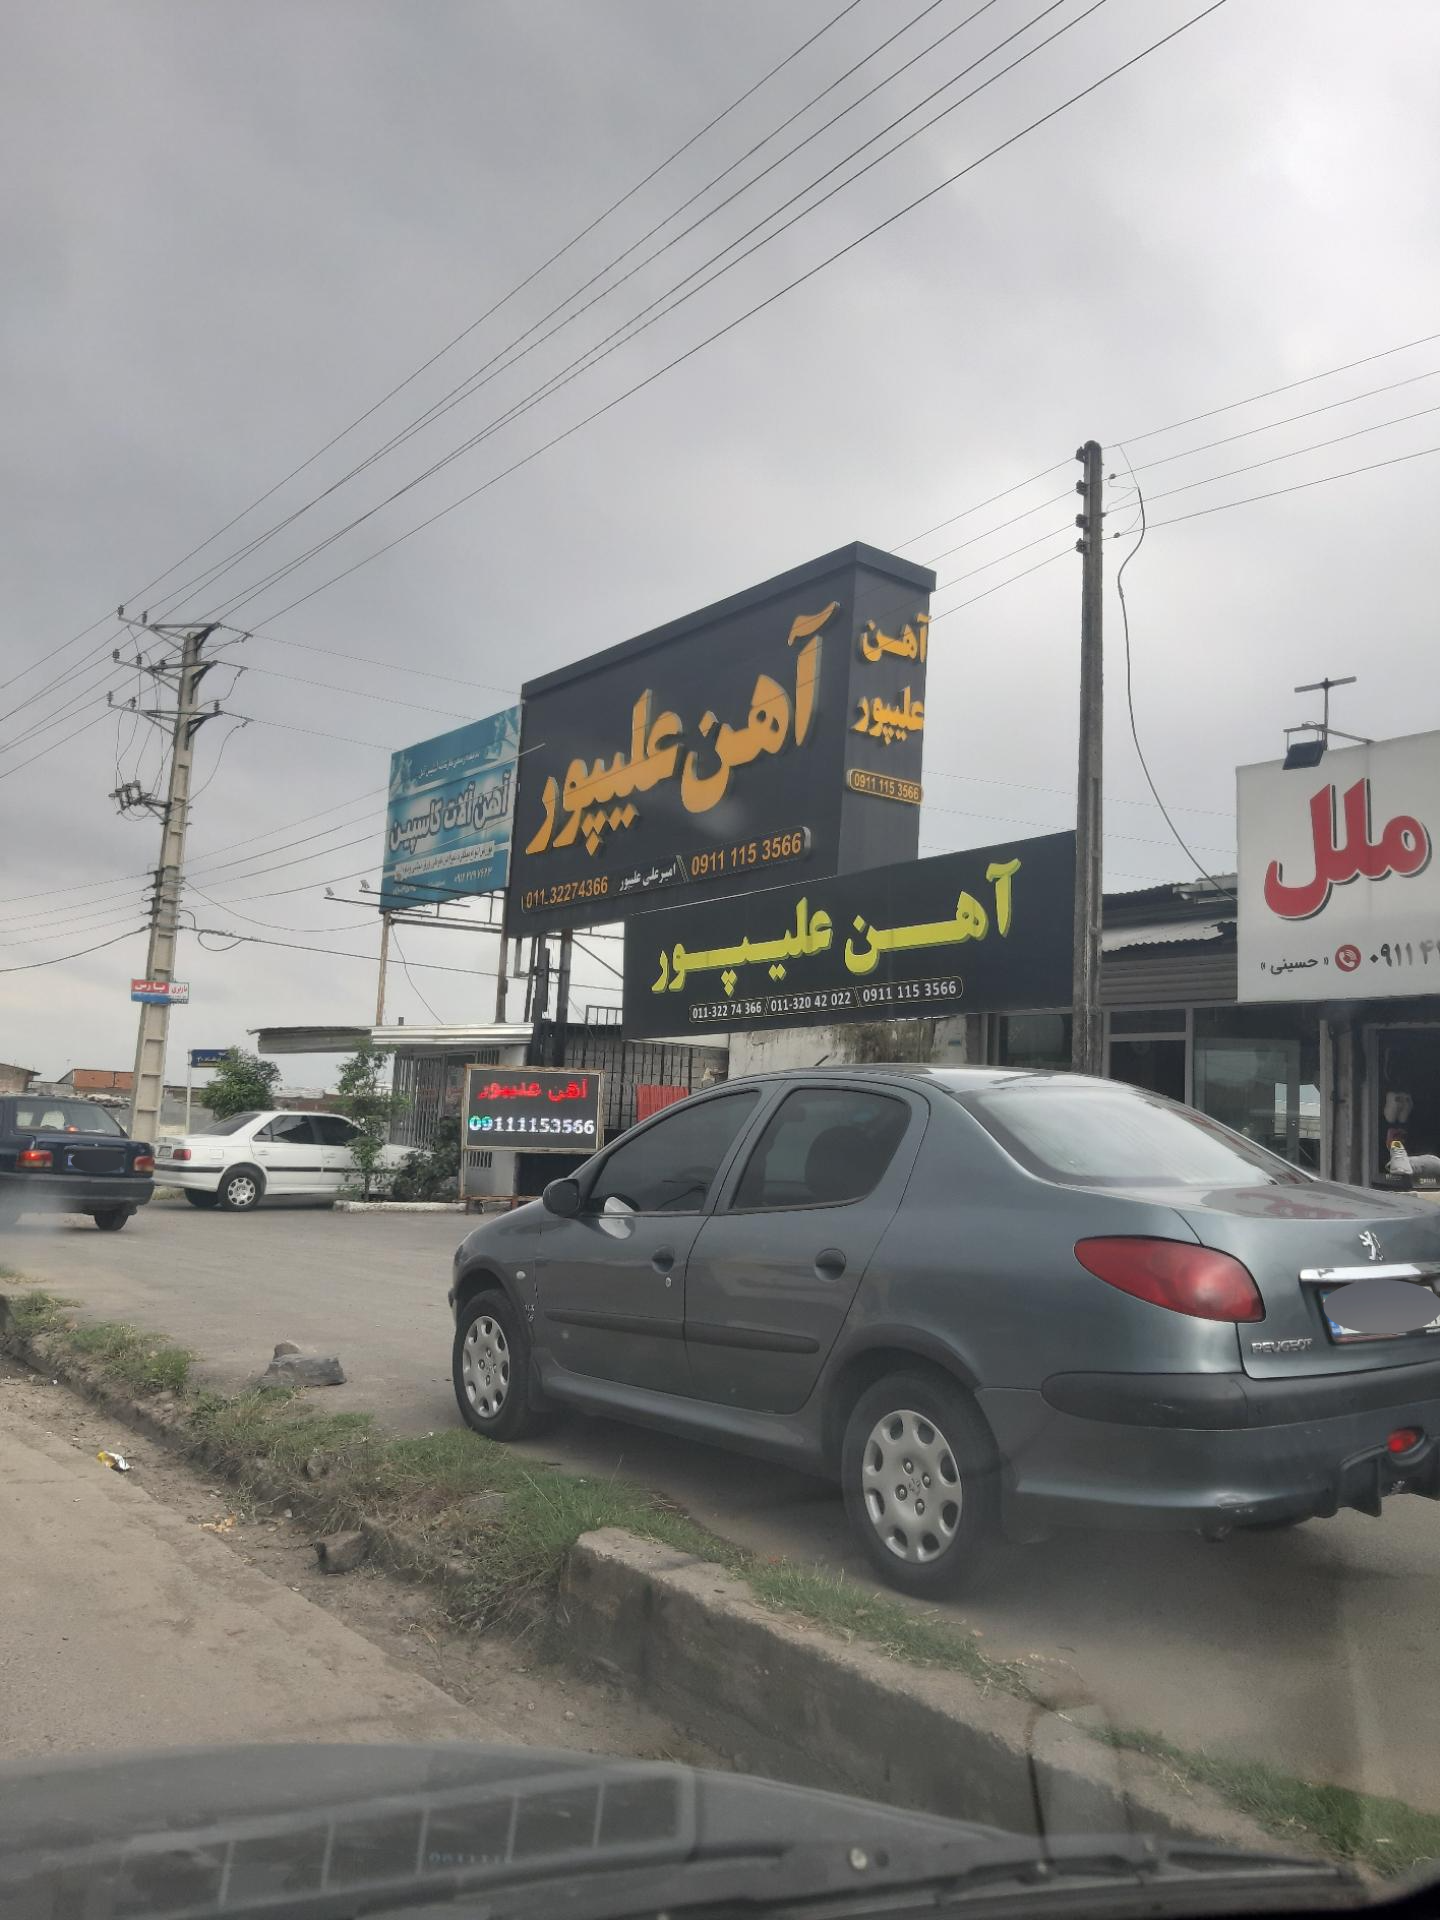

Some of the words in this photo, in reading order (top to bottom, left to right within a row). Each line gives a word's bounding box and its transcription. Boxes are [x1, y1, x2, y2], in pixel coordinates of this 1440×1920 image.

[862, 612, 932, 663] آهن
[681, 600, 841, 814] آهن
[851, 686, 925, 745] علیپور
[525, 688, 684, 856] علیپور
[854, 774, 876, 790] 0911
[879, 779, 895, 795] 115
[897, 783, 919, 800] 3566
[690, 850, 726, 876] 0911
[730, 842, 758, 868] 115
[761, 832, 802, 861] 3566
[1263, 777, 1432, 921] ملل
[844, 857, 1023, 976] آهن
[651, 896, 834, 997] علیپور
[692, 1003, 728, 1020] 011-322
[730, 1002, 742, 1017] 74
[744, 1001, 762, 1016] 366
[770, 997, 811, 1013] 011-320
[814, 995, 828, 1009] 42
[830, 991, 851, 1007] 022
[862, 987, 893, 1003] 0911
[897, 983, 920, 999] 115
[924, 980, 957, 997] 3566
[469, 1115, 595, 1135] 09111153566
[1251, 1337, 1313, 1353] PEUGEOT
